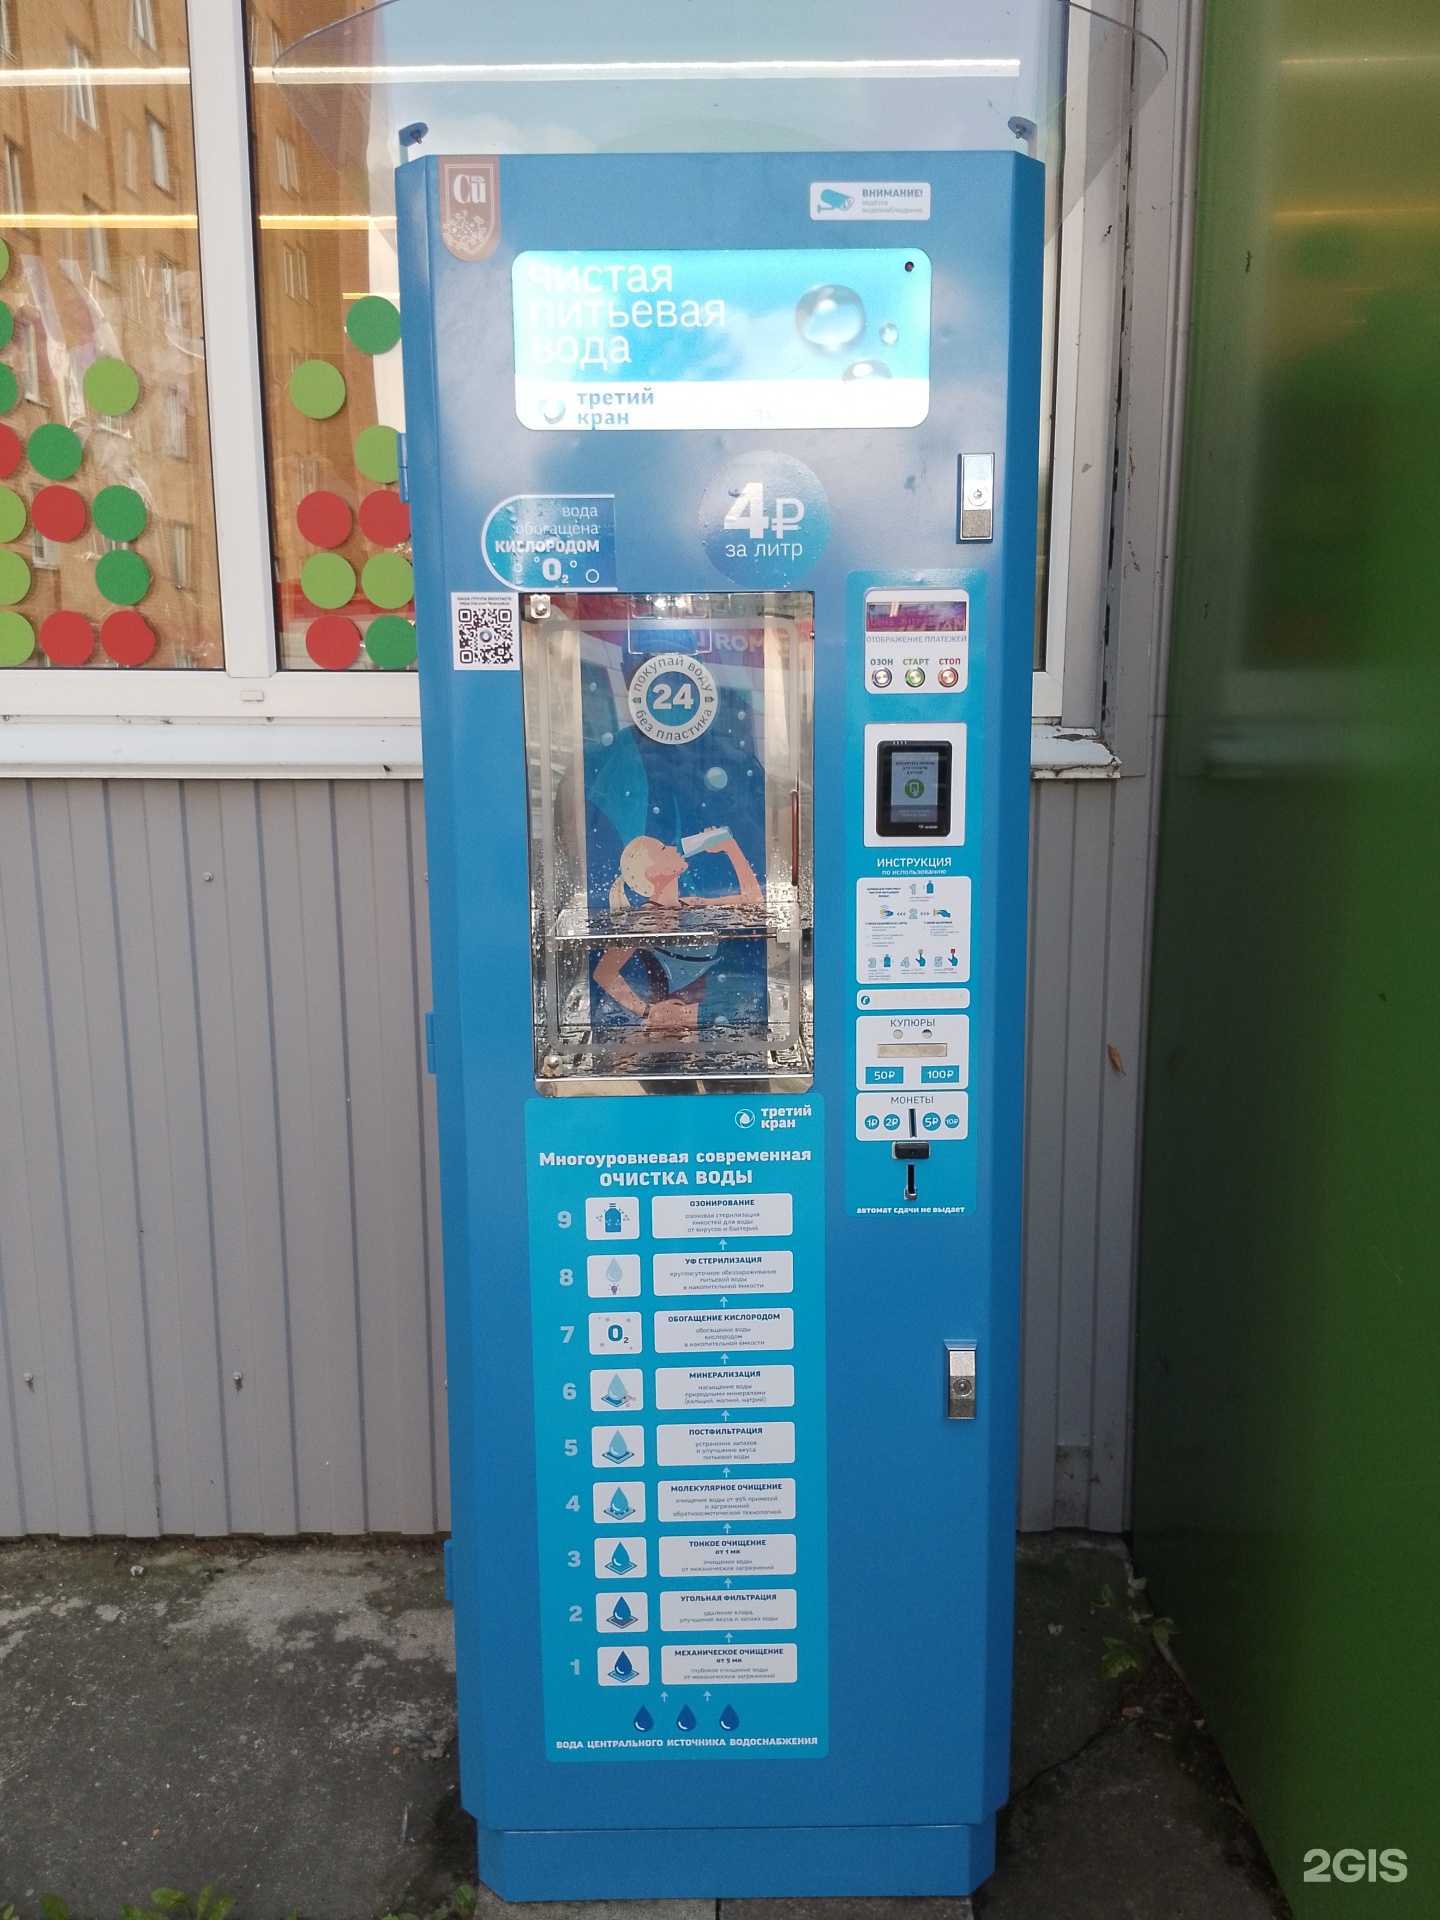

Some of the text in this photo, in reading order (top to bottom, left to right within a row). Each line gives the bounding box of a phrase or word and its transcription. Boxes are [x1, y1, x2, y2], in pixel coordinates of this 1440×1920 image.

[862, 188, 924, 198] ВНИМАНИЕ!
[529, 297, 726, 328] питьевая
[530, 335, 633, 372] вода
[576, 387, 655, 409] третий
[577, 411, 630, 430] кран
[562, 506, 598, 520] вода
[725, 543, 803, 561] за литр
[870, 658, 894, 666] ОЗОН
[902, 658, 929, 666] СТАРТ
[938, 657, 961, 665] СТОП
[634, 655, 714, 693] покупай воду
[651, 683, 694, 710] 24
[635, 708, 713, 741] без пластика
[876, 857, 952, 869] ИНСТРУКЦИЯ
[890, 1018, 936, 1028] КУПЮРЫ
[890, 1096, 934, 1104] МОНЕТЫ
[761, 1104, 812, 1118] третий
[761, 1118, 796, 1131] кран
[539, 1150, 812, 1168] Многоуровневая современная
[599, 1169, 753, 1187] ОЧИСТКА ВОДЫ
[689, 1199, 755, 1207] ОЗОНИРОВАНИЕ
[893, 1207, 919, 1215] сдачи
[933, 1206, 966, 1214] выдает
[556, 1210, 572, 1229] 9
[698, 1256, 763, 1265] СТЕРИЛИЗАЦИЯ
[558, 1268, 574, 1287] 8
[667, 1313, 781, 1323] ОБОГАЩЕНИЕ КИСЛОРОДОМ
[560, 1326, 575, 1344] 7
[689, 1370, 761, 1379] МИНЕРАЛИЗАЦИЯ
[561, 1382, 577, 1400] 6
[689, 1427, 763, 1436] ПОСТФИЛЬТРАЦИЯ
[564, 1439, 578, 1457] 5
[670, 1483, 783, 1493] МОЛЕКУЛЯРНОЕ ОЧИЩЕНИЕ
[565, 1495, 580, 1513] 4
[688, 1539, 767, 1548] ТОНКОЕ ОЧИЩЕНИЕ
[567, 1549, 582, 1568] 3
[680, 1593, 777, 1602] УГОЛЬНАЯ ФИЛЬТРАЦИЯ
[568, 1605, 583, 1622] 2
[674, 1647, 784, 1657] МЕХАНИЧЕСКОЕ ОЧИЩЕНИЕ
[570, 1658, 581, 1676] 1
[556, 1736, 818, 1749] ВОДА ЦЕНТРАЛЬНОГО ИСТОЧНИКА ВОДОСНАБЖЕНИЯ
